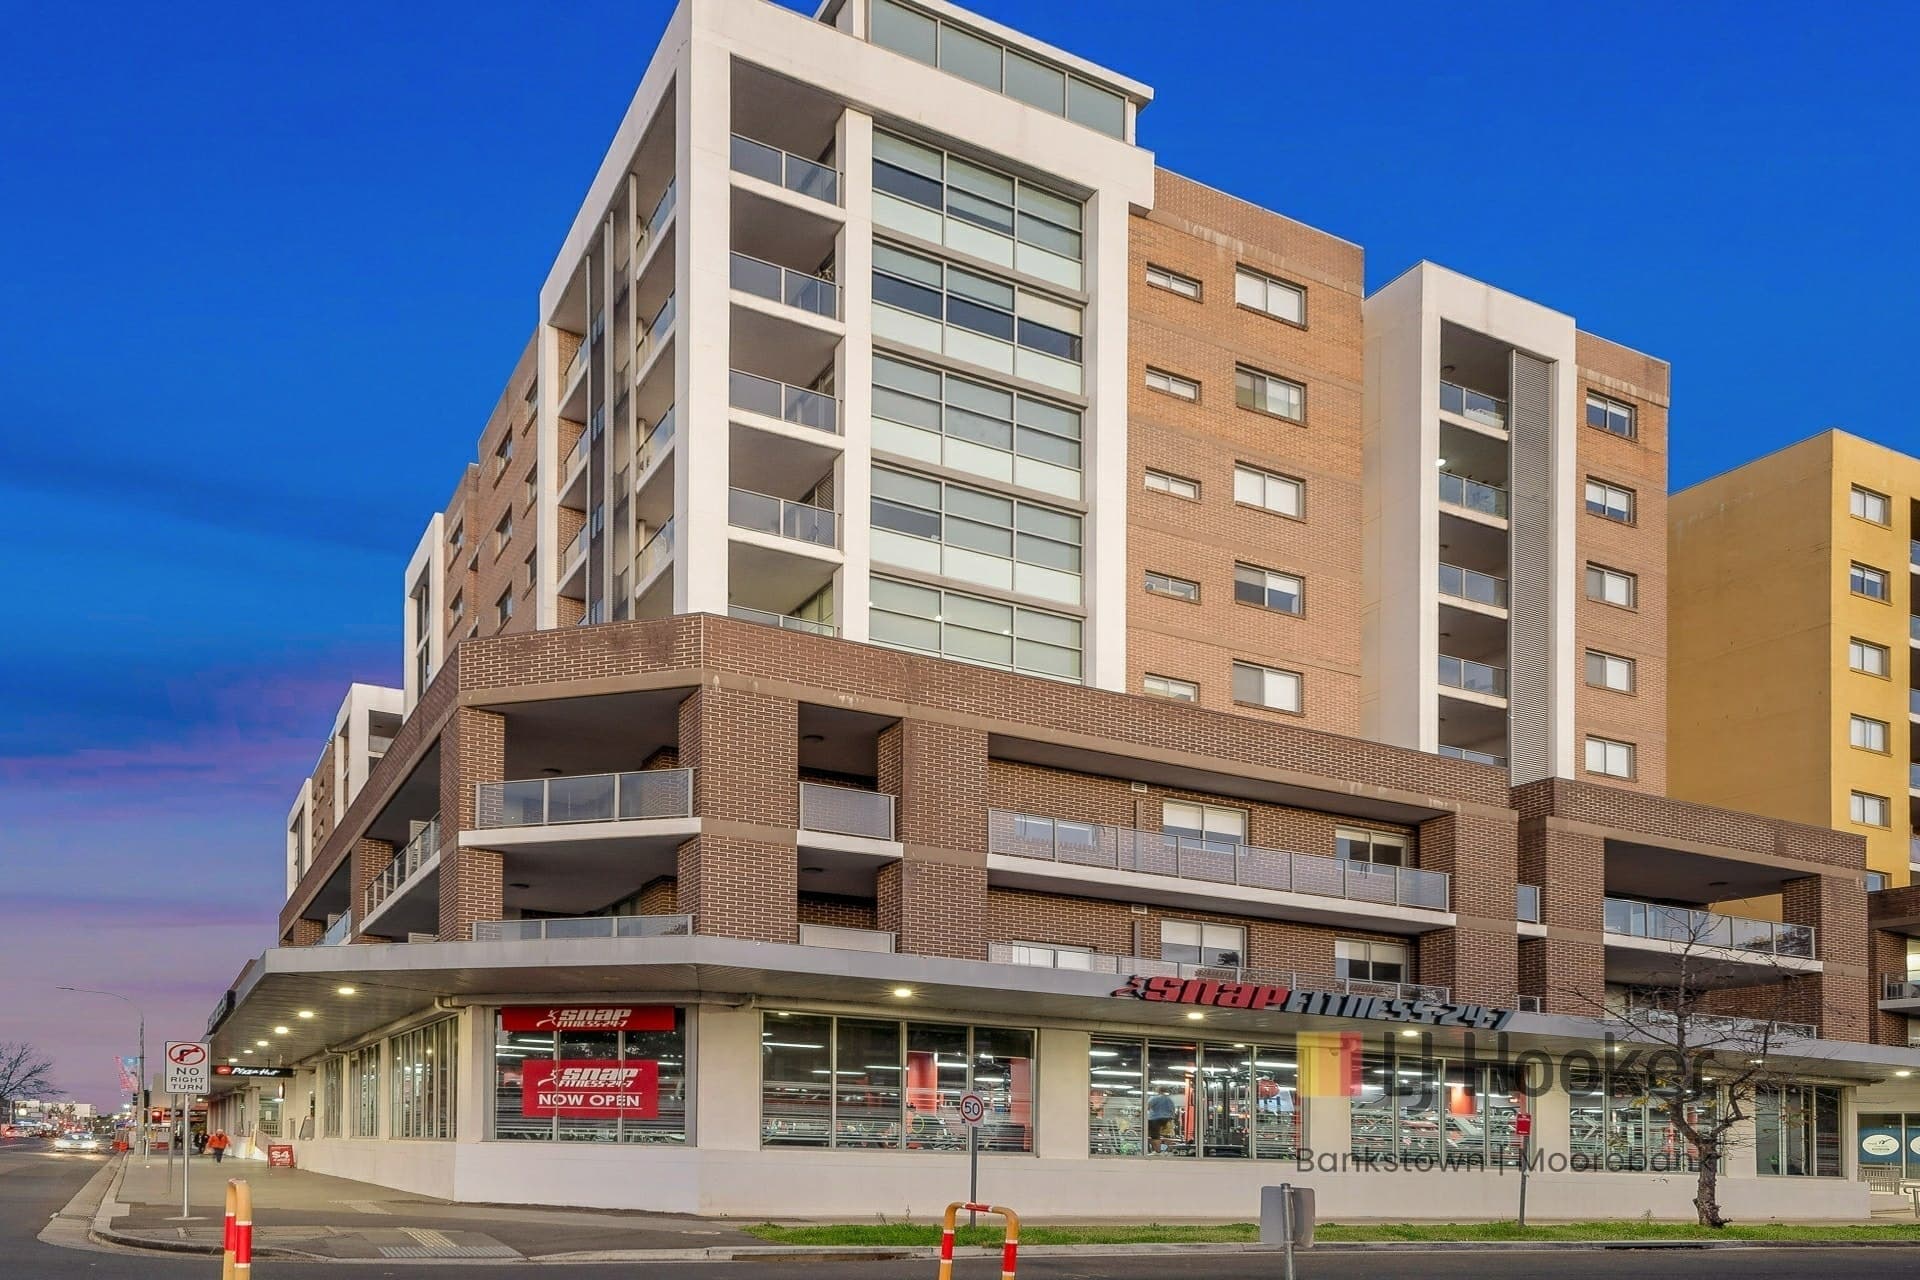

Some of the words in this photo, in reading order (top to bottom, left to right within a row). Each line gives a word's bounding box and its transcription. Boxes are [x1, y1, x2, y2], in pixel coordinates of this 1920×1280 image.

[176, 1067, 200, 1076] NO
[232, 1067, 258, 1076] Pizza
[539, 1094, 585, 1106] NOW
[589, 1094, 640, 1107] OPEN
[965, 1102, 980, 1116] 50
